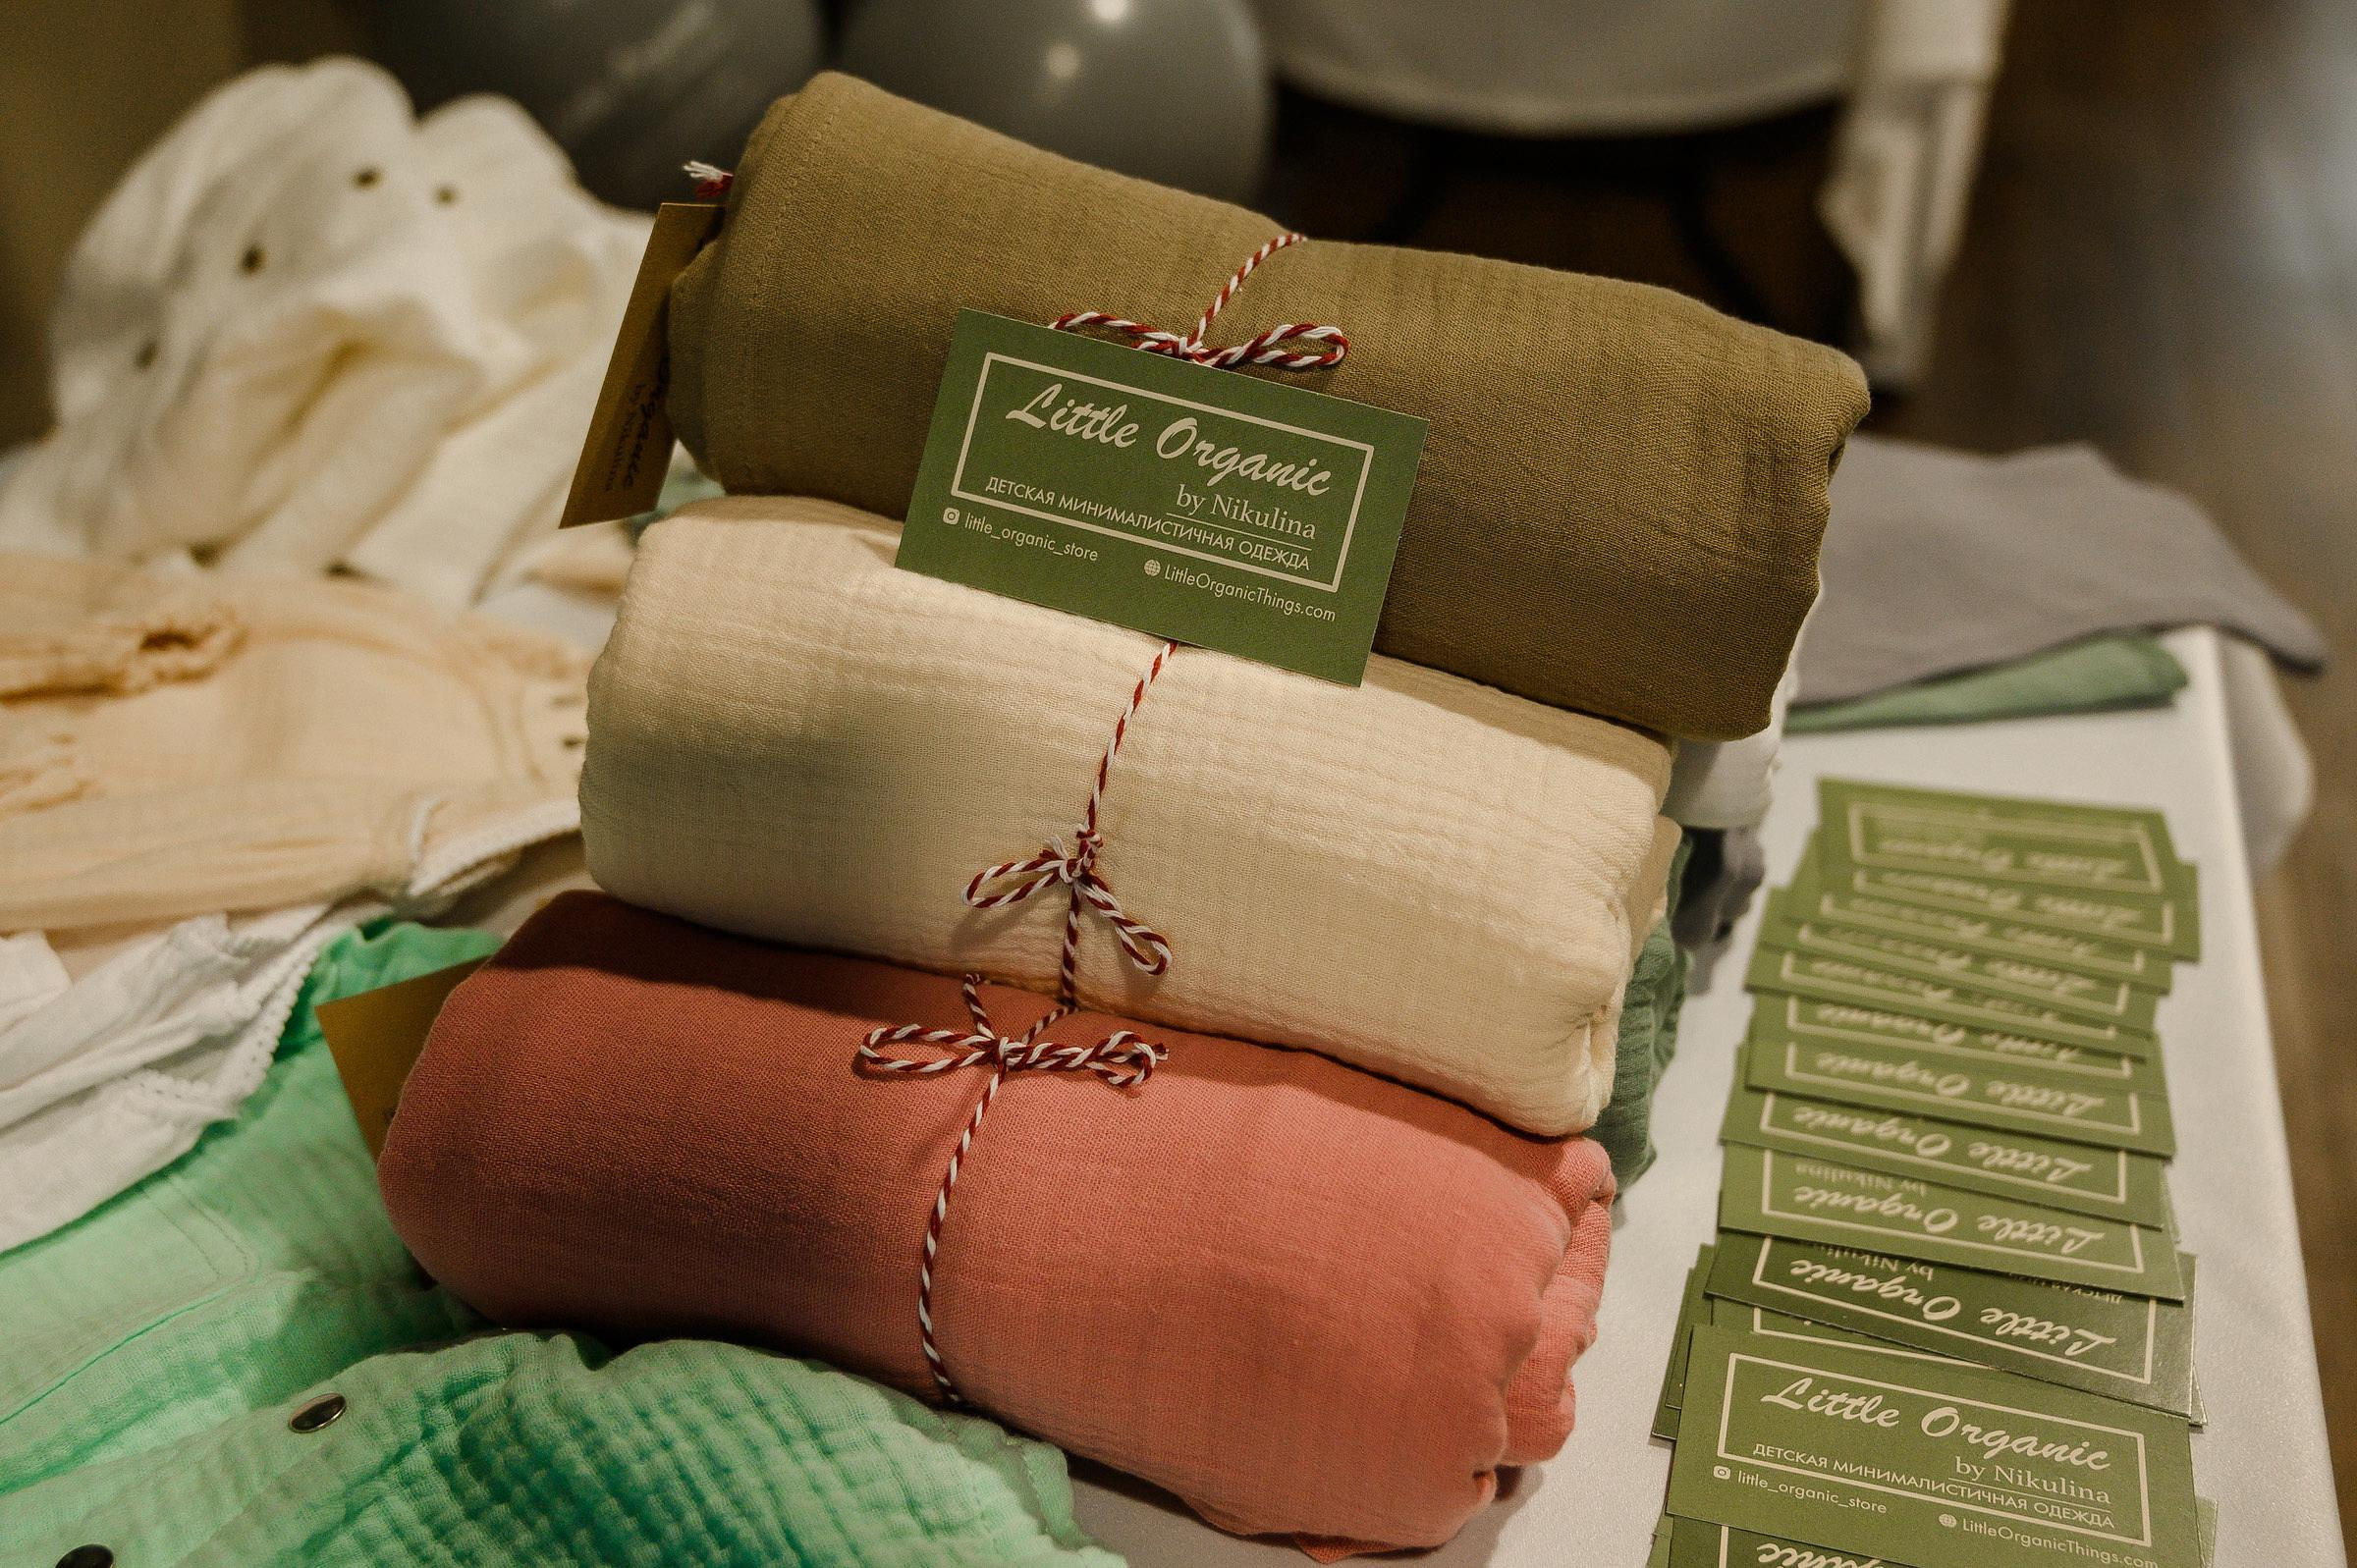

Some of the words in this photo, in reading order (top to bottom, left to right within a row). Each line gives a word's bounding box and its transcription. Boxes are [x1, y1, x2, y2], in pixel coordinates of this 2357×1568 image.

[1005, 383, 1139, 449] Little
[1155, 416, 1333, 497] Organic
[964, 512, 1099, 562] little_organic_store
[985, 476, 1055, 506] ДЕТСКАЯ
[1059, 494, 1234, 553] МИНИМАЛИСТИЧНАЯ
[1238, 537, 1311, 571] ОДЕЖДА
[1177, 484, 1205, 516] by
[1210, 496, 1318, 541] Nikulina
[1164, 564, 1337, 622] LittleOrganicThings.com
[1793, 1107, 1951, 1157] Organic
[1968, 1142, 2093, 1182] Little
[1793, 1186, 1959, 1233] Organic
[1977, 1215, 2106, 1254] Little
[1789, 1259, 1961, 1321] Organic
[1980, 1308, 2117, 1357] Little
[1760, 1377, 1900, 1428] Little
[1920, 1405, 2111, 1471] Organic
[1737, 1470, 1887, 1514] little_organic_store
[1753, 1443, 1828, 1469] ДЕТСКАЯ
[1833, 1460, 2027, 1511] МИНИМАЛИСТИЧНАЯ
[2034, 1502, 2114, 1529] ОДЕЖДА
[1955, 1456, 1986, 1482] by
[1995, 1465, 2110, 1504] Nikulina
[1963, 1518, 2159, 1568] LittleOrganicThings.com
